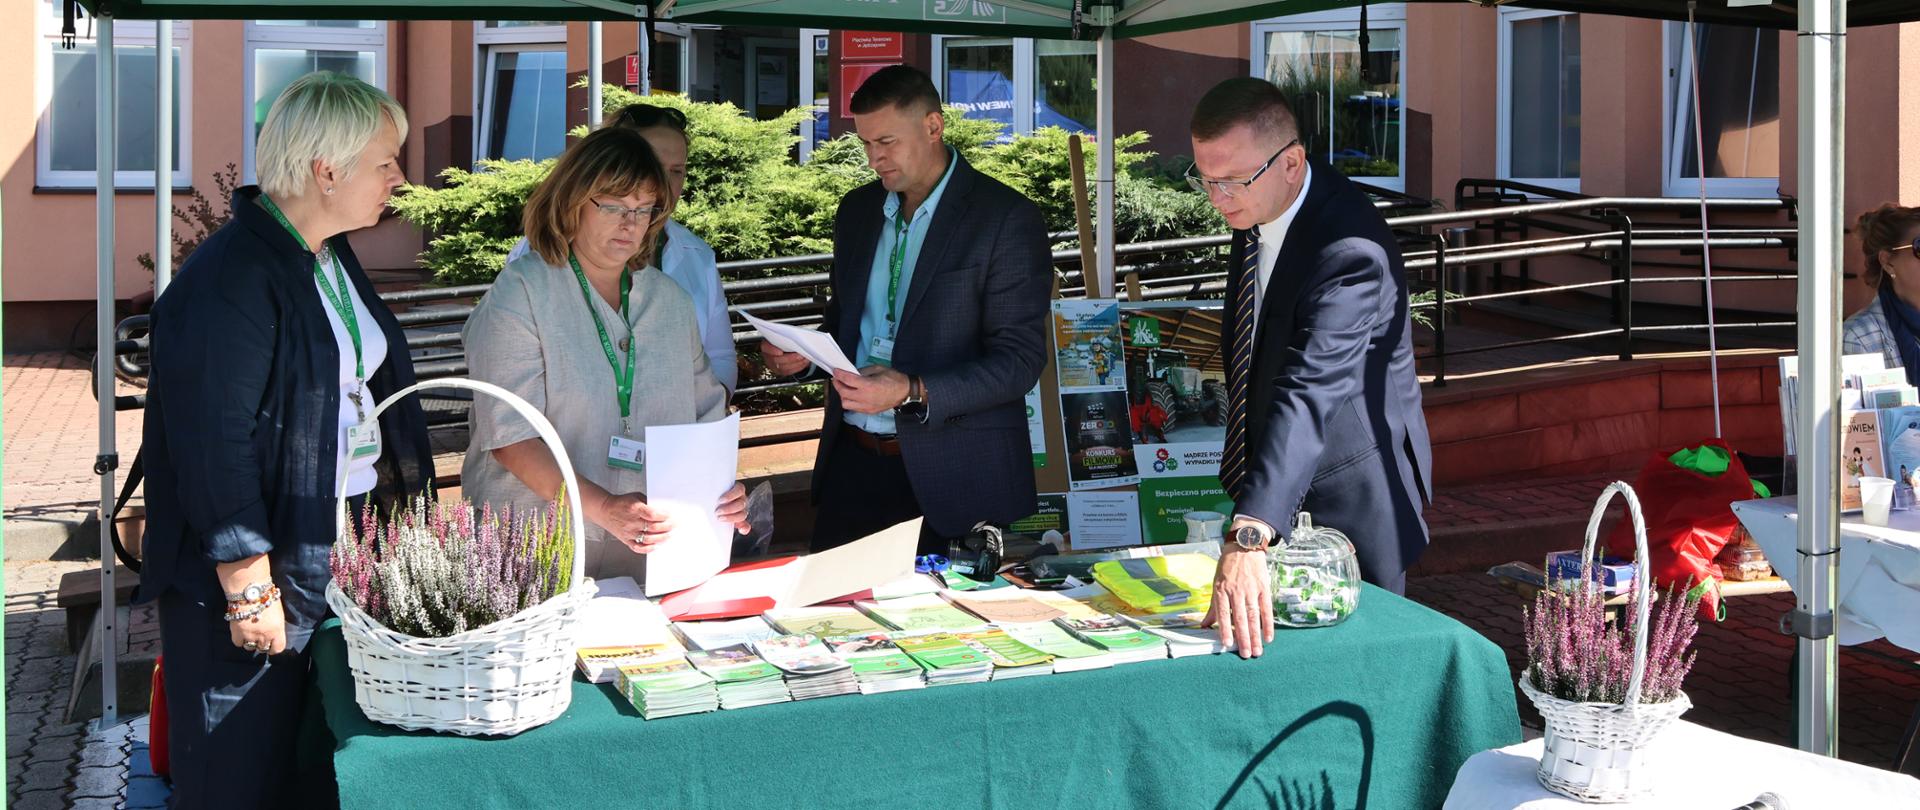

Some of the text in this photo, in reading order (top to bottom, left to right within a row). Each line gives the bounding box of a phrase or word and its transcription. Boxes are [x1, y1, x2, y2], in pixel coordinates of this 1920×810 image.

[1183, 451, 1209, 459] MĄDRZE
[1184, 458, 1215, 466] WYPADKU
[1155, 488, 1224, 499] Bezpieczna praca
